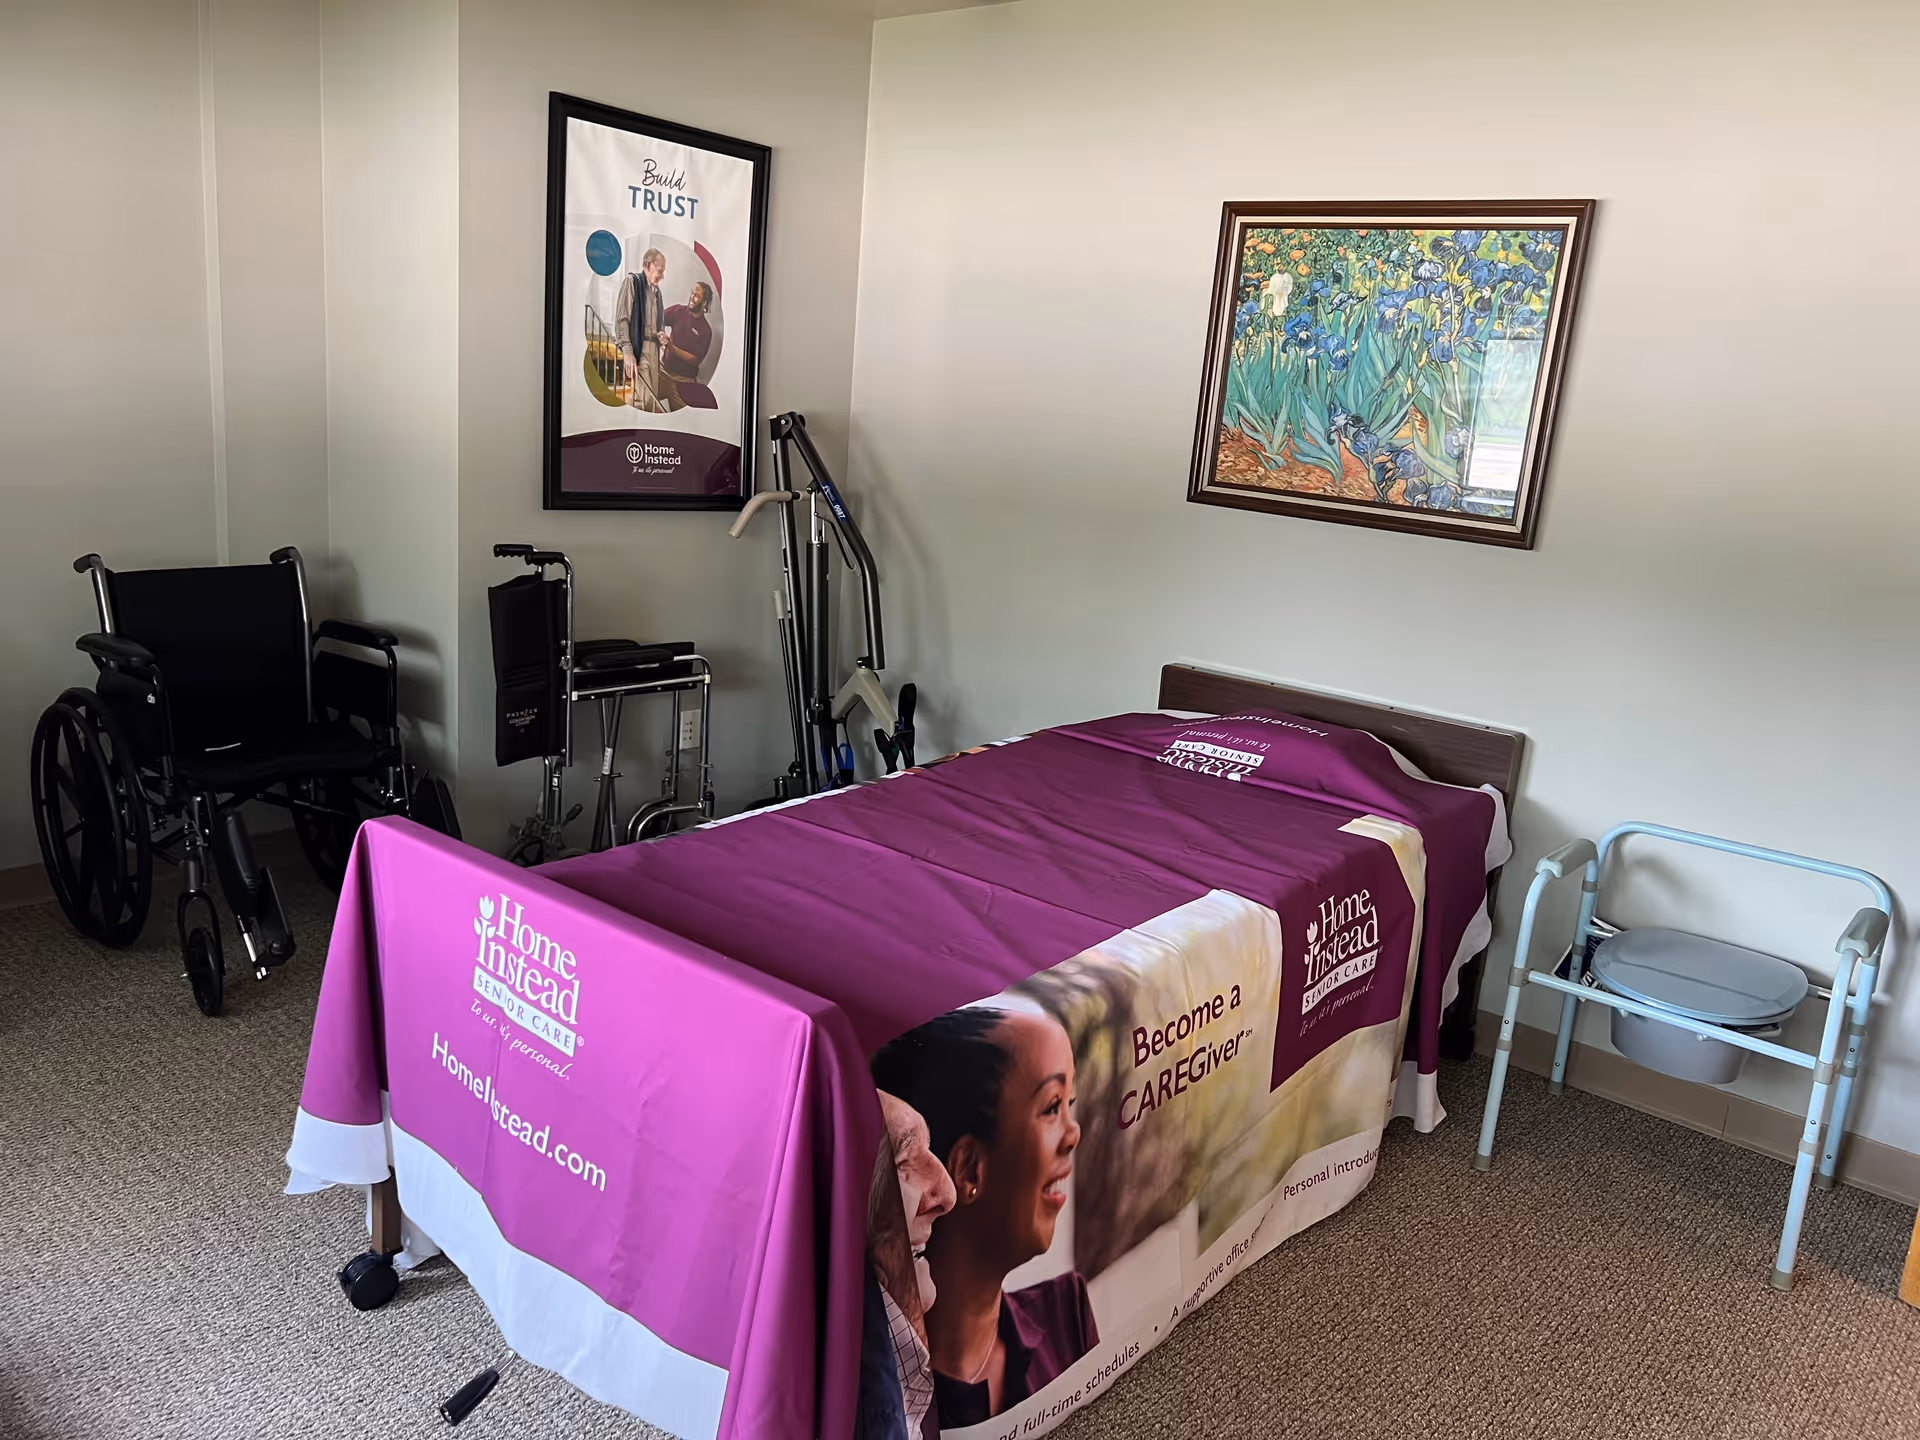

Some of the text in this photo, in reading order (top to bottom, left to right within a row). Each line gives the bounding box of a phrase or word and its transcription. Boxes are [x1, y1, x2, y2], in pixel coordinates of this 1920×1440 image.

[628, 185, 699, 219] TRUST
[642, 159, 686, 191] Build
[644, 443, 675, 455] Home
[644, 453, 681, 465] Instead
[1175, 742, 1260, 764] SENIOR CARE
[496, 893, 577, 980] Home
[1317, 889, 1372, 944] Home
[475, 916, 580, 1025] Instead
[1303, 905, 1380, 988] Instead
[470, 998, 482, 1015] To
[1304, 954, 1375, 1008] SENIOR CARE
[477, 974, 572, 1049] SENIOR CARE
[1132, 984, 1242, 1069] Become a
[1283, 1165, 1330, 1201] Personal
[1170, 1305, 1179, 1323] A
[1225, 1239, 1249, 1266] office
[1023, 1389, 1082, 1434] full-time
[1085, 1341, 1140, 1395] schedules
